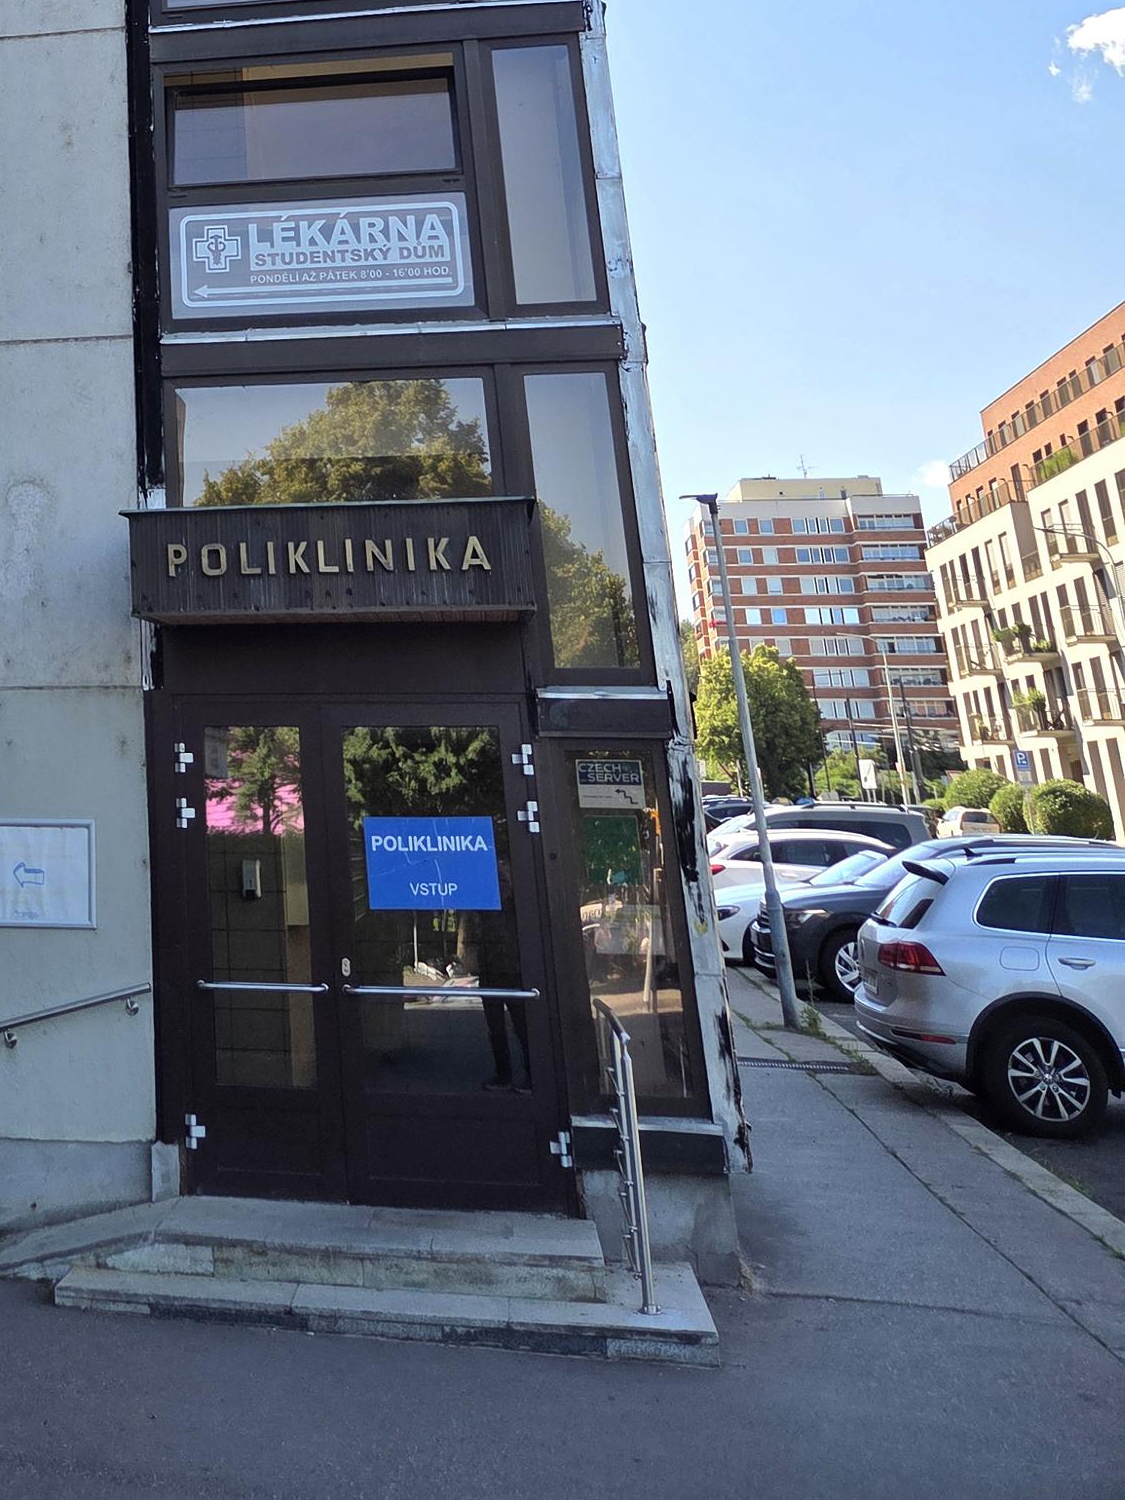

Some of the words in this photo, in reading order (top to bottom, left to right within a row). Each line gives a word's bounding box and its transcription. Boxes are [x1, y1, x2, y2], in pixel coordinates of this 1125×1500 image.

[248, 211, 449, 248] LÉKÁRNA
[255, 244, 391, 267] STUDENTSKÝ
[399, 241, 444, 260] DŮM
[302, 270, 317, 282] AŽ
[320, 268, 358, 280] PÁTEK
[166, 535, 492, 577] POLIKLINIKA
[578, 763, 622, 773] CZECH
[587, 773, 640, 783] SERVER
[371, 835, 488, 851] POLIKLINIKA
[410, 883, 458, 896] VSTUP
